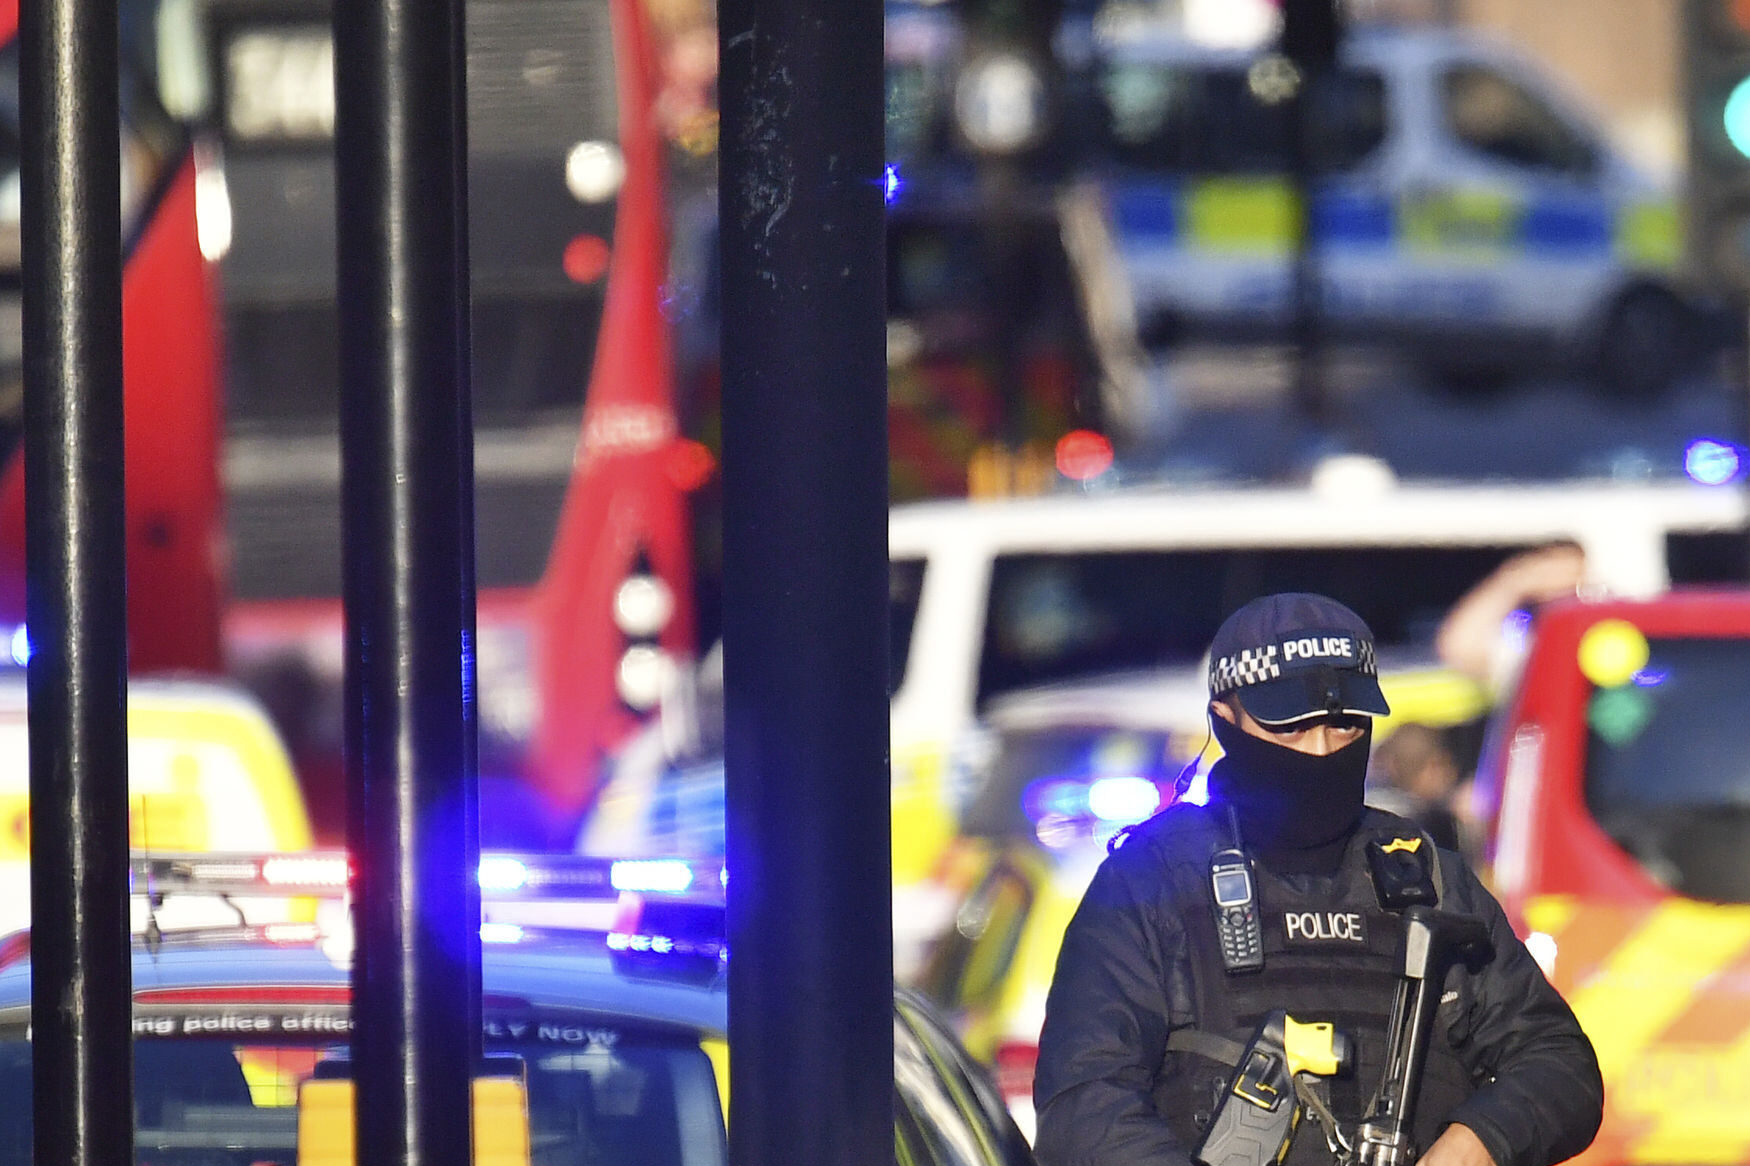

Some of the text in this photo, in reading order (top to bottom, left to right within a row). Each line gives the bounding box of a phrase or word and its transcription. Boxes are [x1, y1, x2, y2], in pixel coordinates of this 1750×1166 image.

[1283, 637, 1353, 662] POLICE
[1285, 912, 1364, 942] POLICE
[183, 1015, 271, 1034] police
[538, 1024, 619, 1045] NOW
